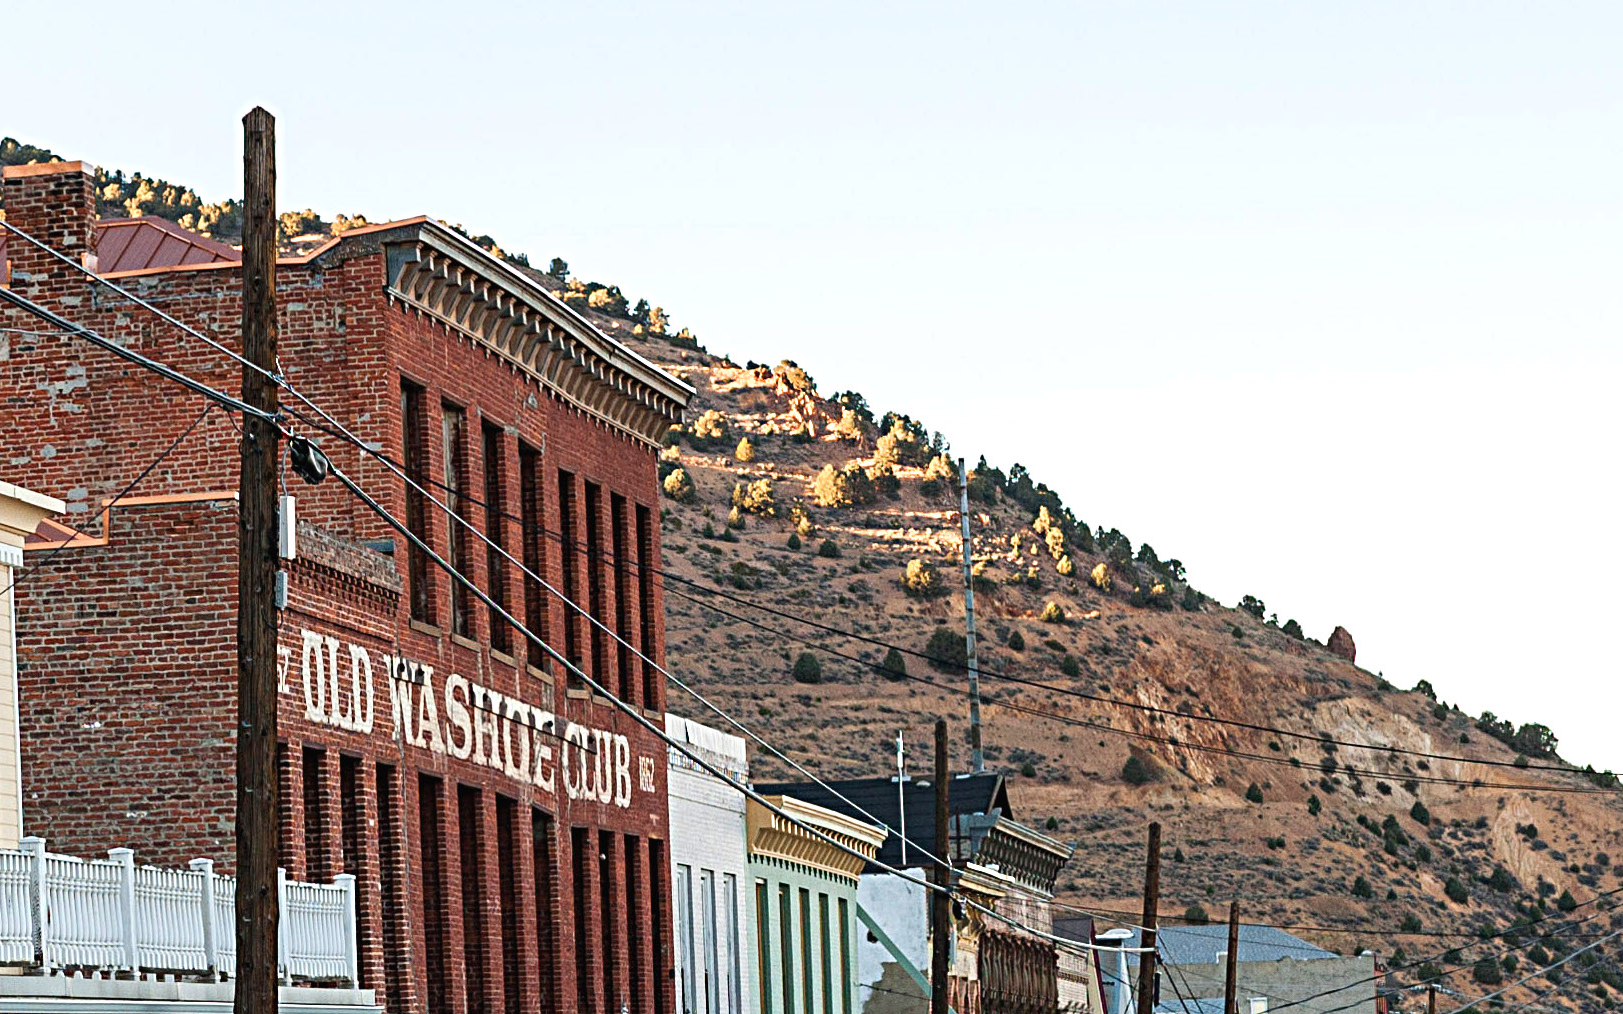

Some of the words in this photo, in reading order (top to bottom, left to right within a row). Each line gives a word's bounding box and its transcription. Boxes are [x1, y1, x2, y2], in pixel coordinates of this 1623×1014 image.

[301, 628, 374, 735] OLD
[384, 653, 555, 794] WASHOE
[560, 717, 633, 808] CLUB
